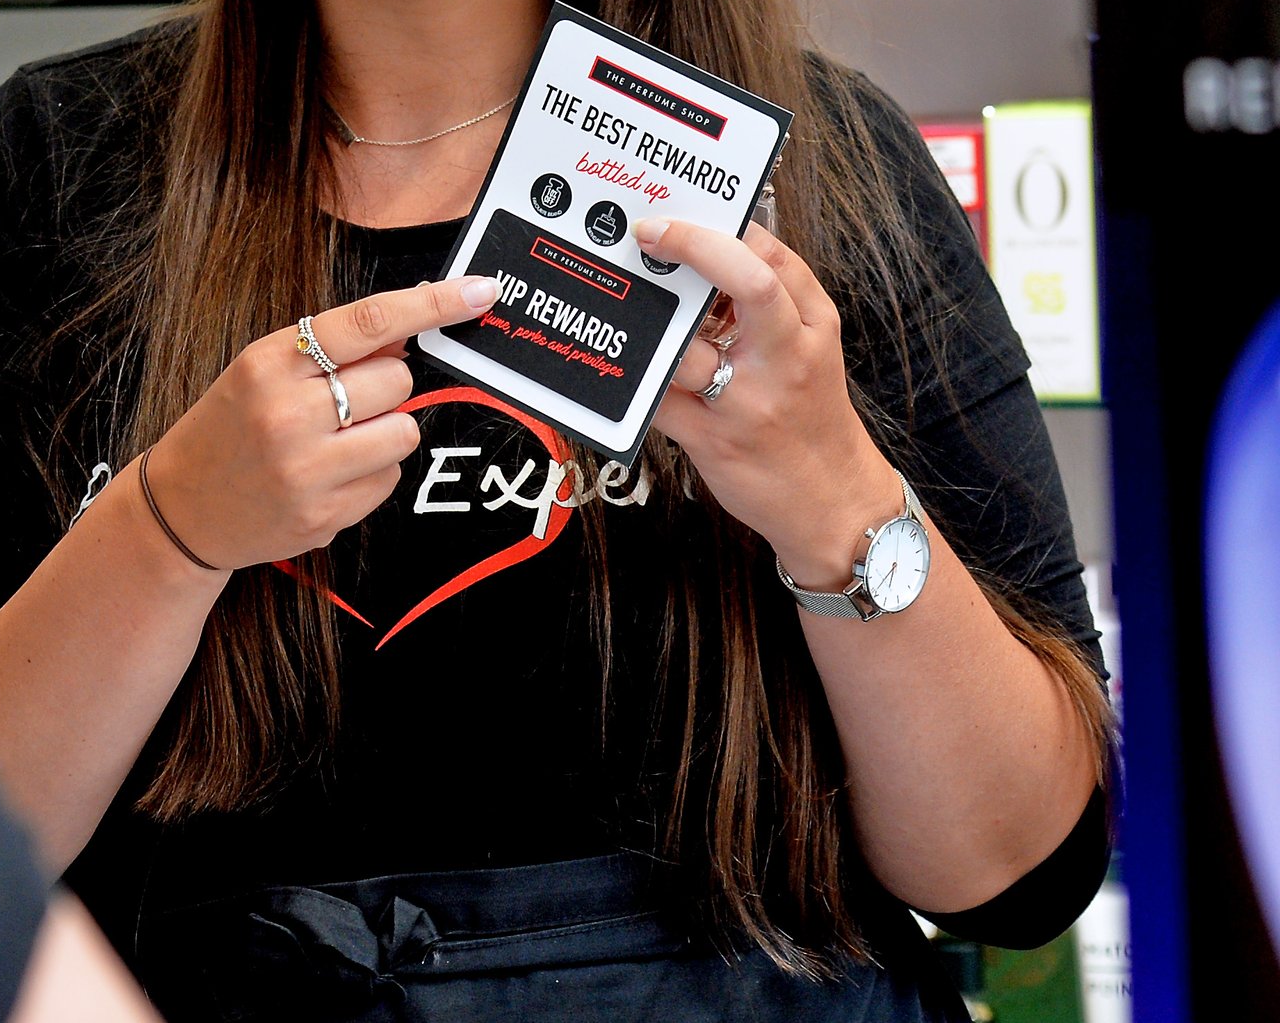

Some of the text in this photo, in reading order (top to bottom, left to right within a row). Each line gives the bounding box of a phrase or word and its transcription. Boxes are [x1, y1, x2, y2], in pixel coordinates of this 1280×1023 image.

[606, 70, 711, 126] THE PERFUME SHOP
[541, 83, 741, 202] THE BEST REWARDS
[575, 151, 671, 204] bottled up
[543, 247, 618, 289] THE PERFUME SHOP
[496, 269, 628, 359] VIP REWARDS
[511, 324, 548, 346] perks
[547, 338, 571, 356] and
[566, 347, 625, 378] privileges
